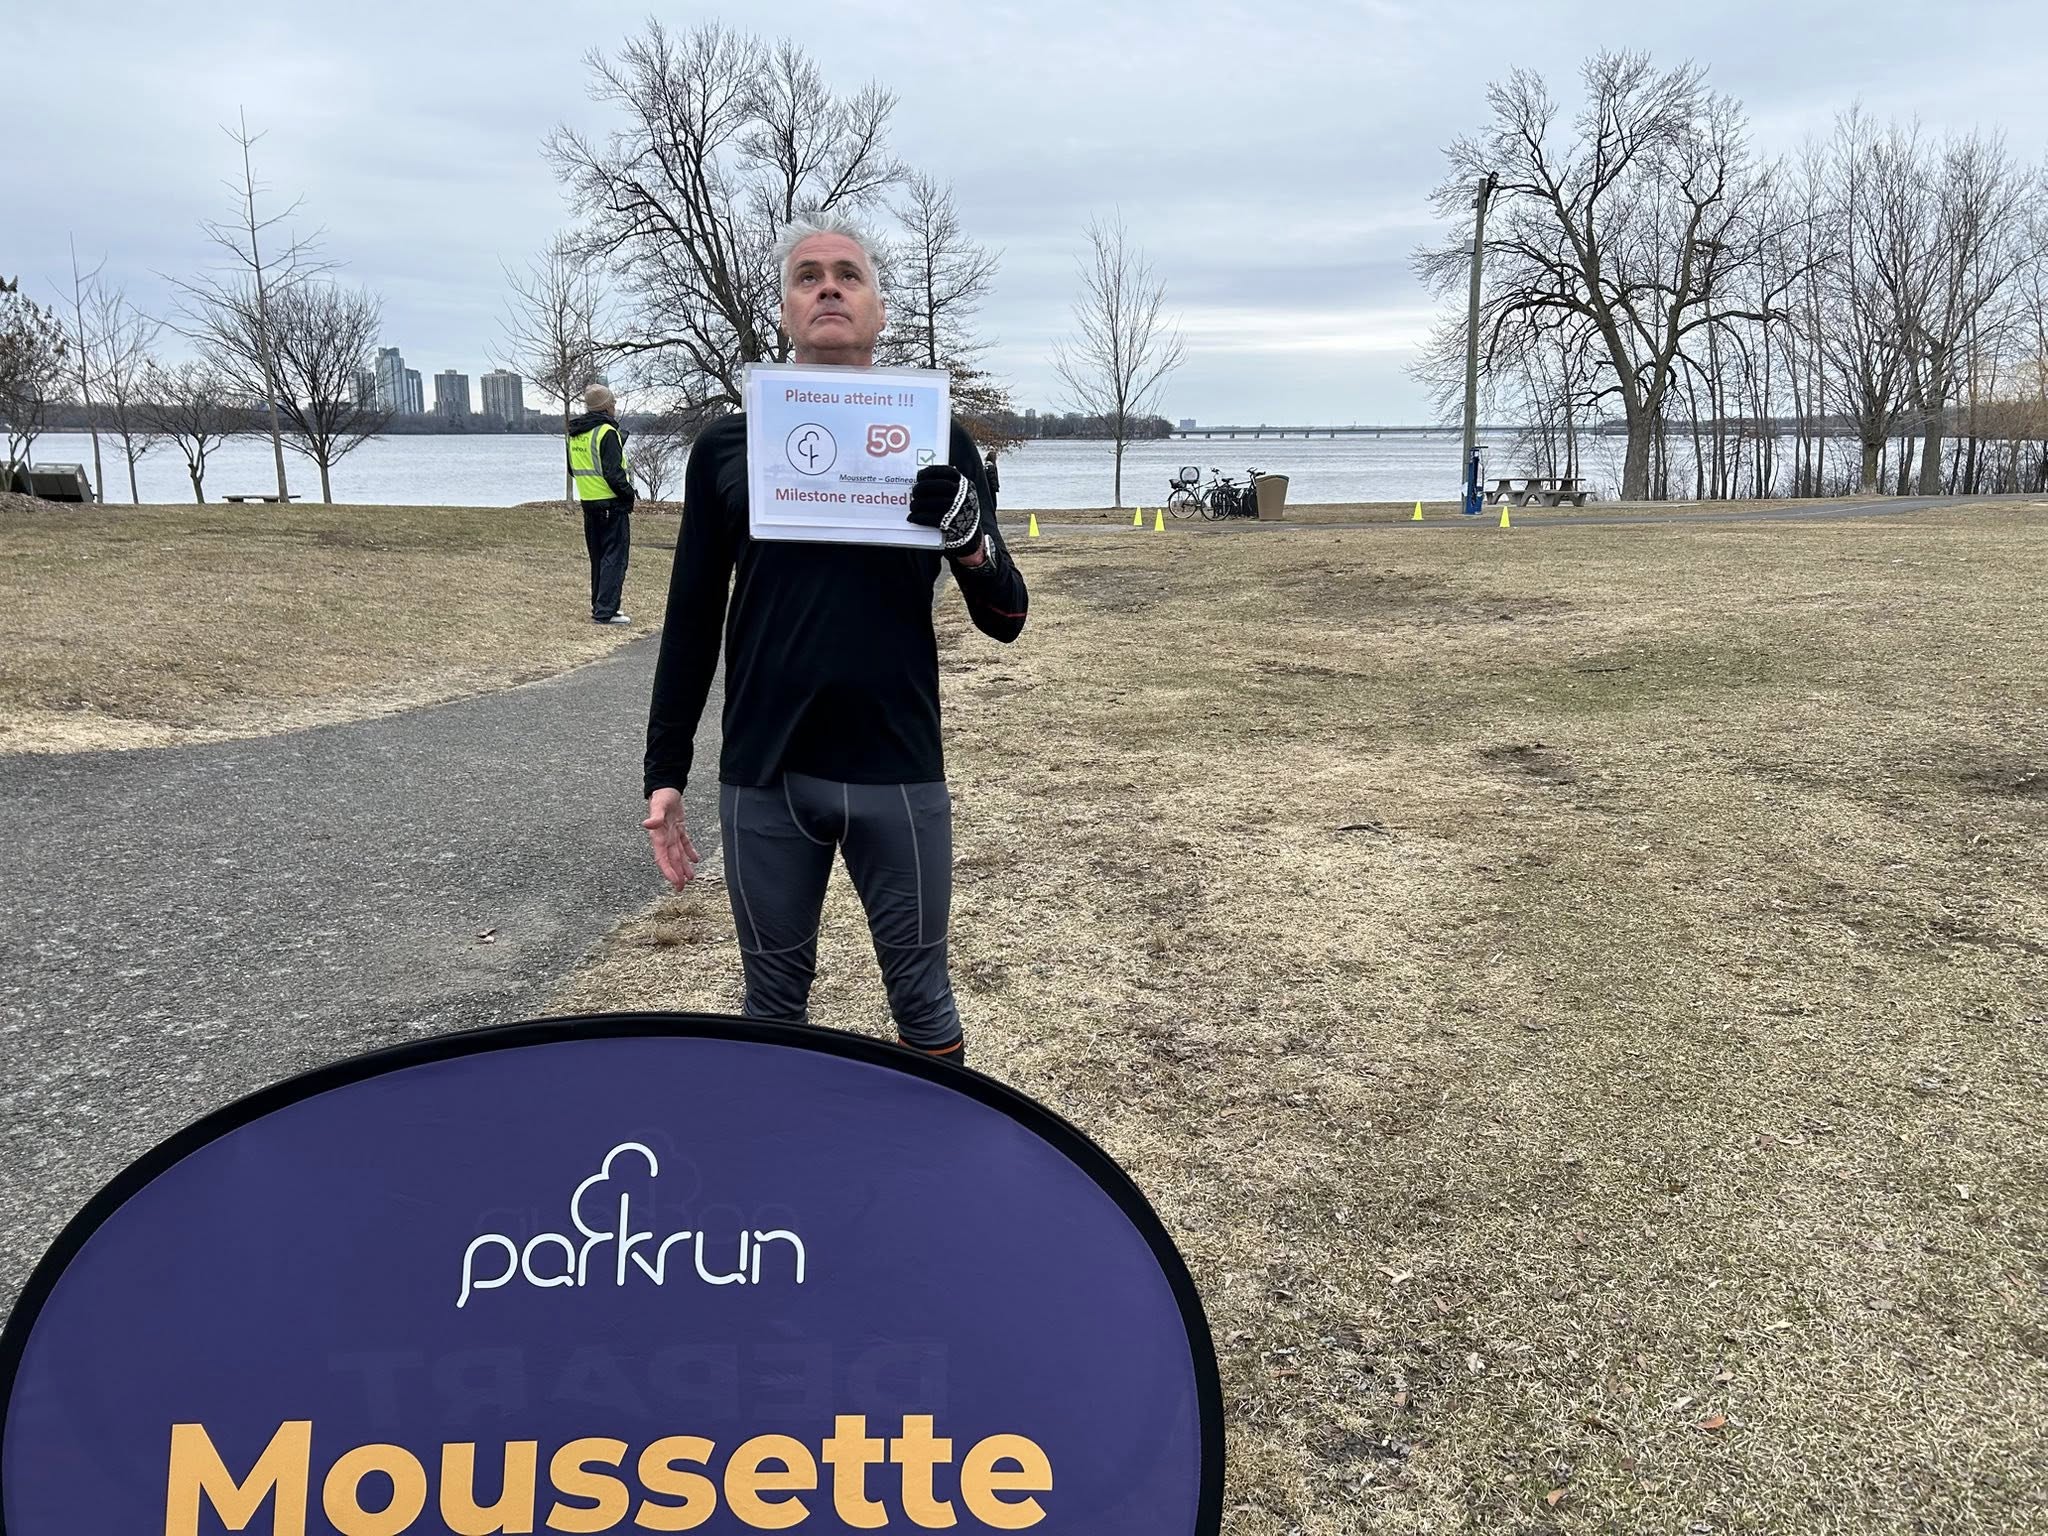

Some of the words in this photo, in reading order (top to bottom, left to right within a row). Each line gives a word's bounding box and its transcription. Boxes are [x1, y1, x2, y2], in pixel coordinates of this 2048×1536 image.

[786, 389, 840, 404] Plateau
[844, 391, 893, 406] atteint
[898, 393, 914, 407] !!!
[870, 428, 906, 453] 50
[840, 474, 877, 482] Moussette
[775, 488, 845, 503] Milestone
[457, 1142, 806, 1307] parkrun
[166, 1415, 1053, 1536] Moussette
